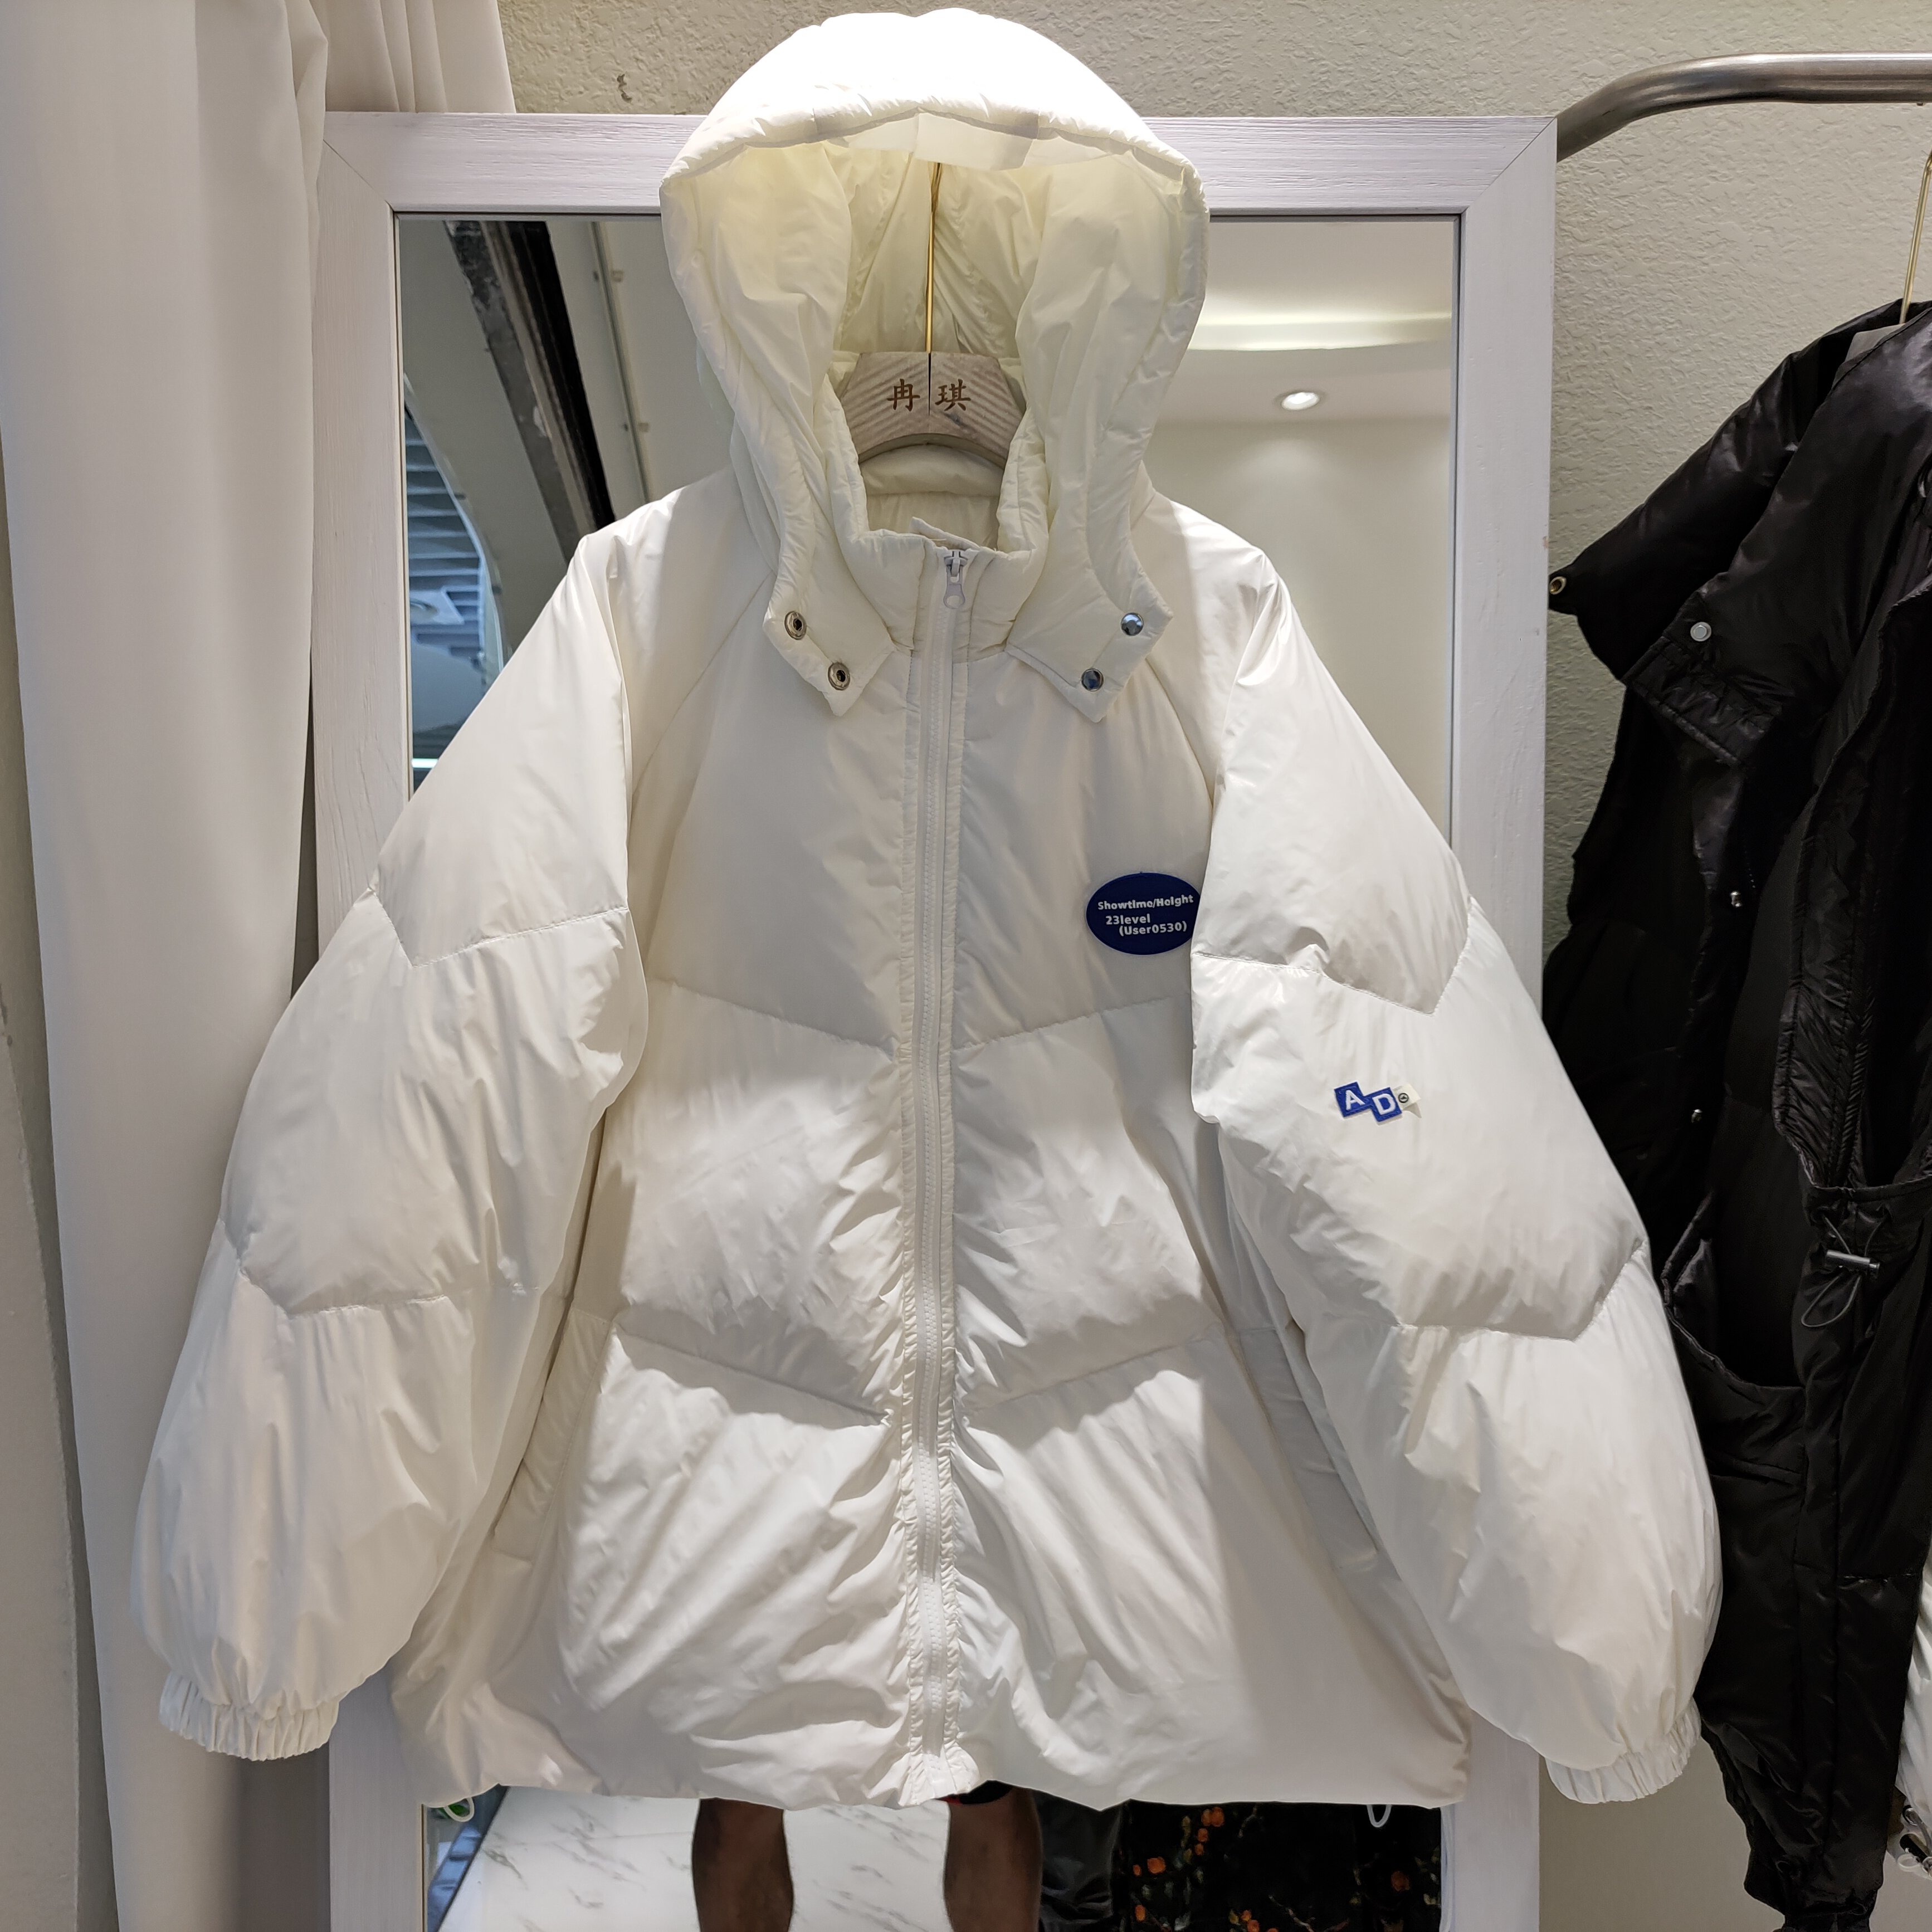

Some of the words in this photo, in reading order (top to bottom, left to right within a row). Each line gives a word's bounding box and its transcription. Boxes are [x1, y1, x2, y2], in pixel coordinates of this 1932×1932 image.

[886, 378, 971, 412] 冉琪
[1105, 913, 1151, 925] 23level
[1119, 920, 1187, 936] (User0530)
